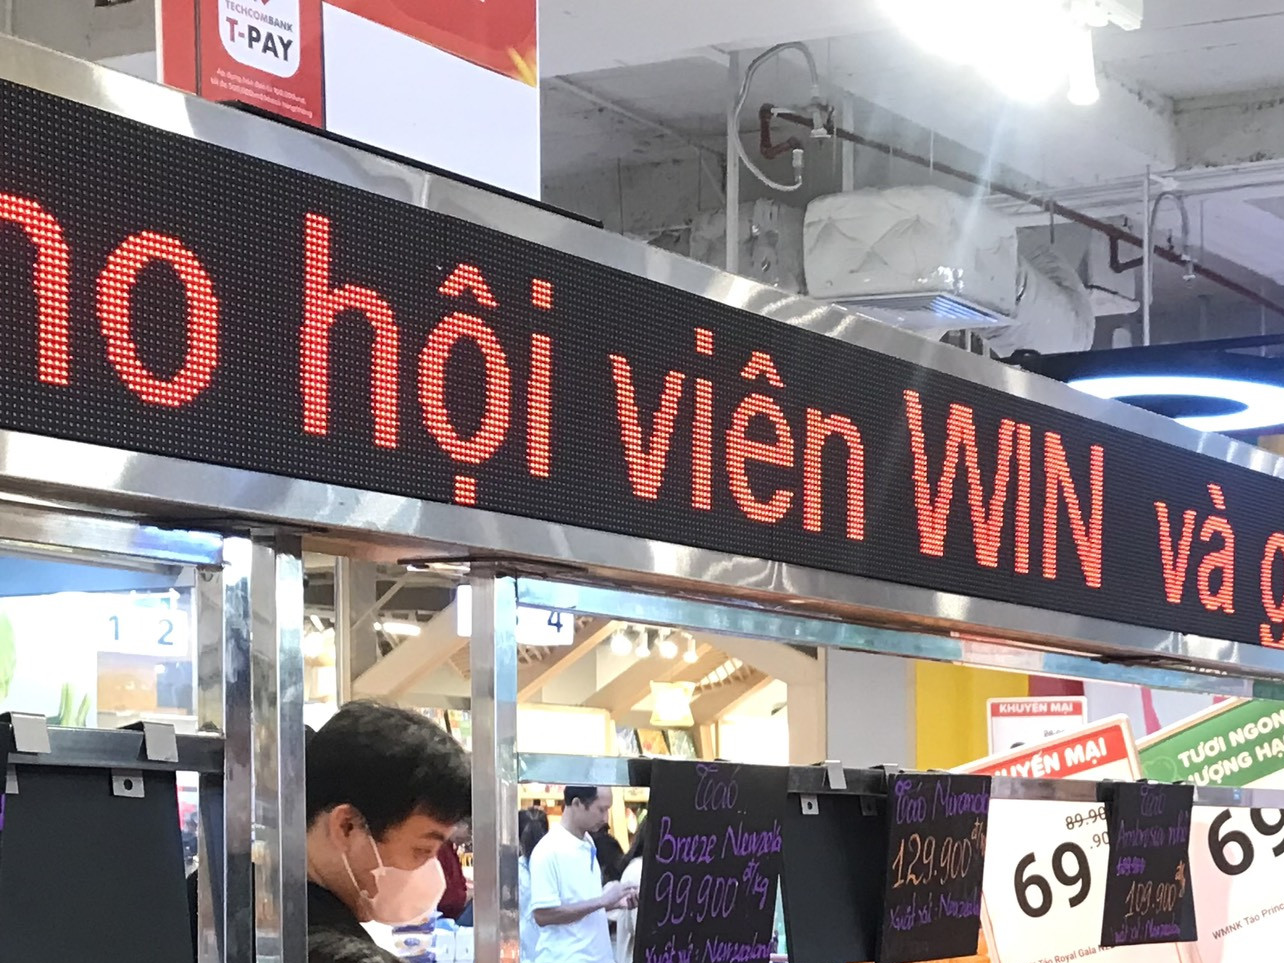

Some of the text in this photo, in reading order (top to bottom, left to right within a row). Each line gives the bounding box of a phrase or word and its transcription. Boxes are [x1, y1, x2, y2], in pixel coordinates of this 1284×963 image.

[225, 1, 293, 32] TECHCOMBANK
[226, 16, 293, 61] T-PAY
[300, 212, 553, 505] hội
[609, 328, 865, 540] viên
[903, 389, 1103, 588] WIN
[1154, 484, 1235, 614] và
[158, 619, 174, 646] 2
[547, 610, 564, 633] 4
[1051, 702, 1073, 715] MẠI
[995, 736, 1107, 778] UYẾN MẠI
[1177, 736, 1227, 768] TƯƠI
[1188, 751, 1253, 785] ƯỢNG
[1065, 806, 1108, 831] 89.90
[656, 815, 717, 865] Breeze
[892, 833, 973, 889] 129.900
[1014, 841, 1092, 918] 69
[655, 871, 739, 927] 99.900
[1212, 920, 1243, 940] WMNK
[1243, 913, 1261, 927] Táo
[1054, 950, 1077, 963] Royal
[1078, 946, 1096, 958] Gala
